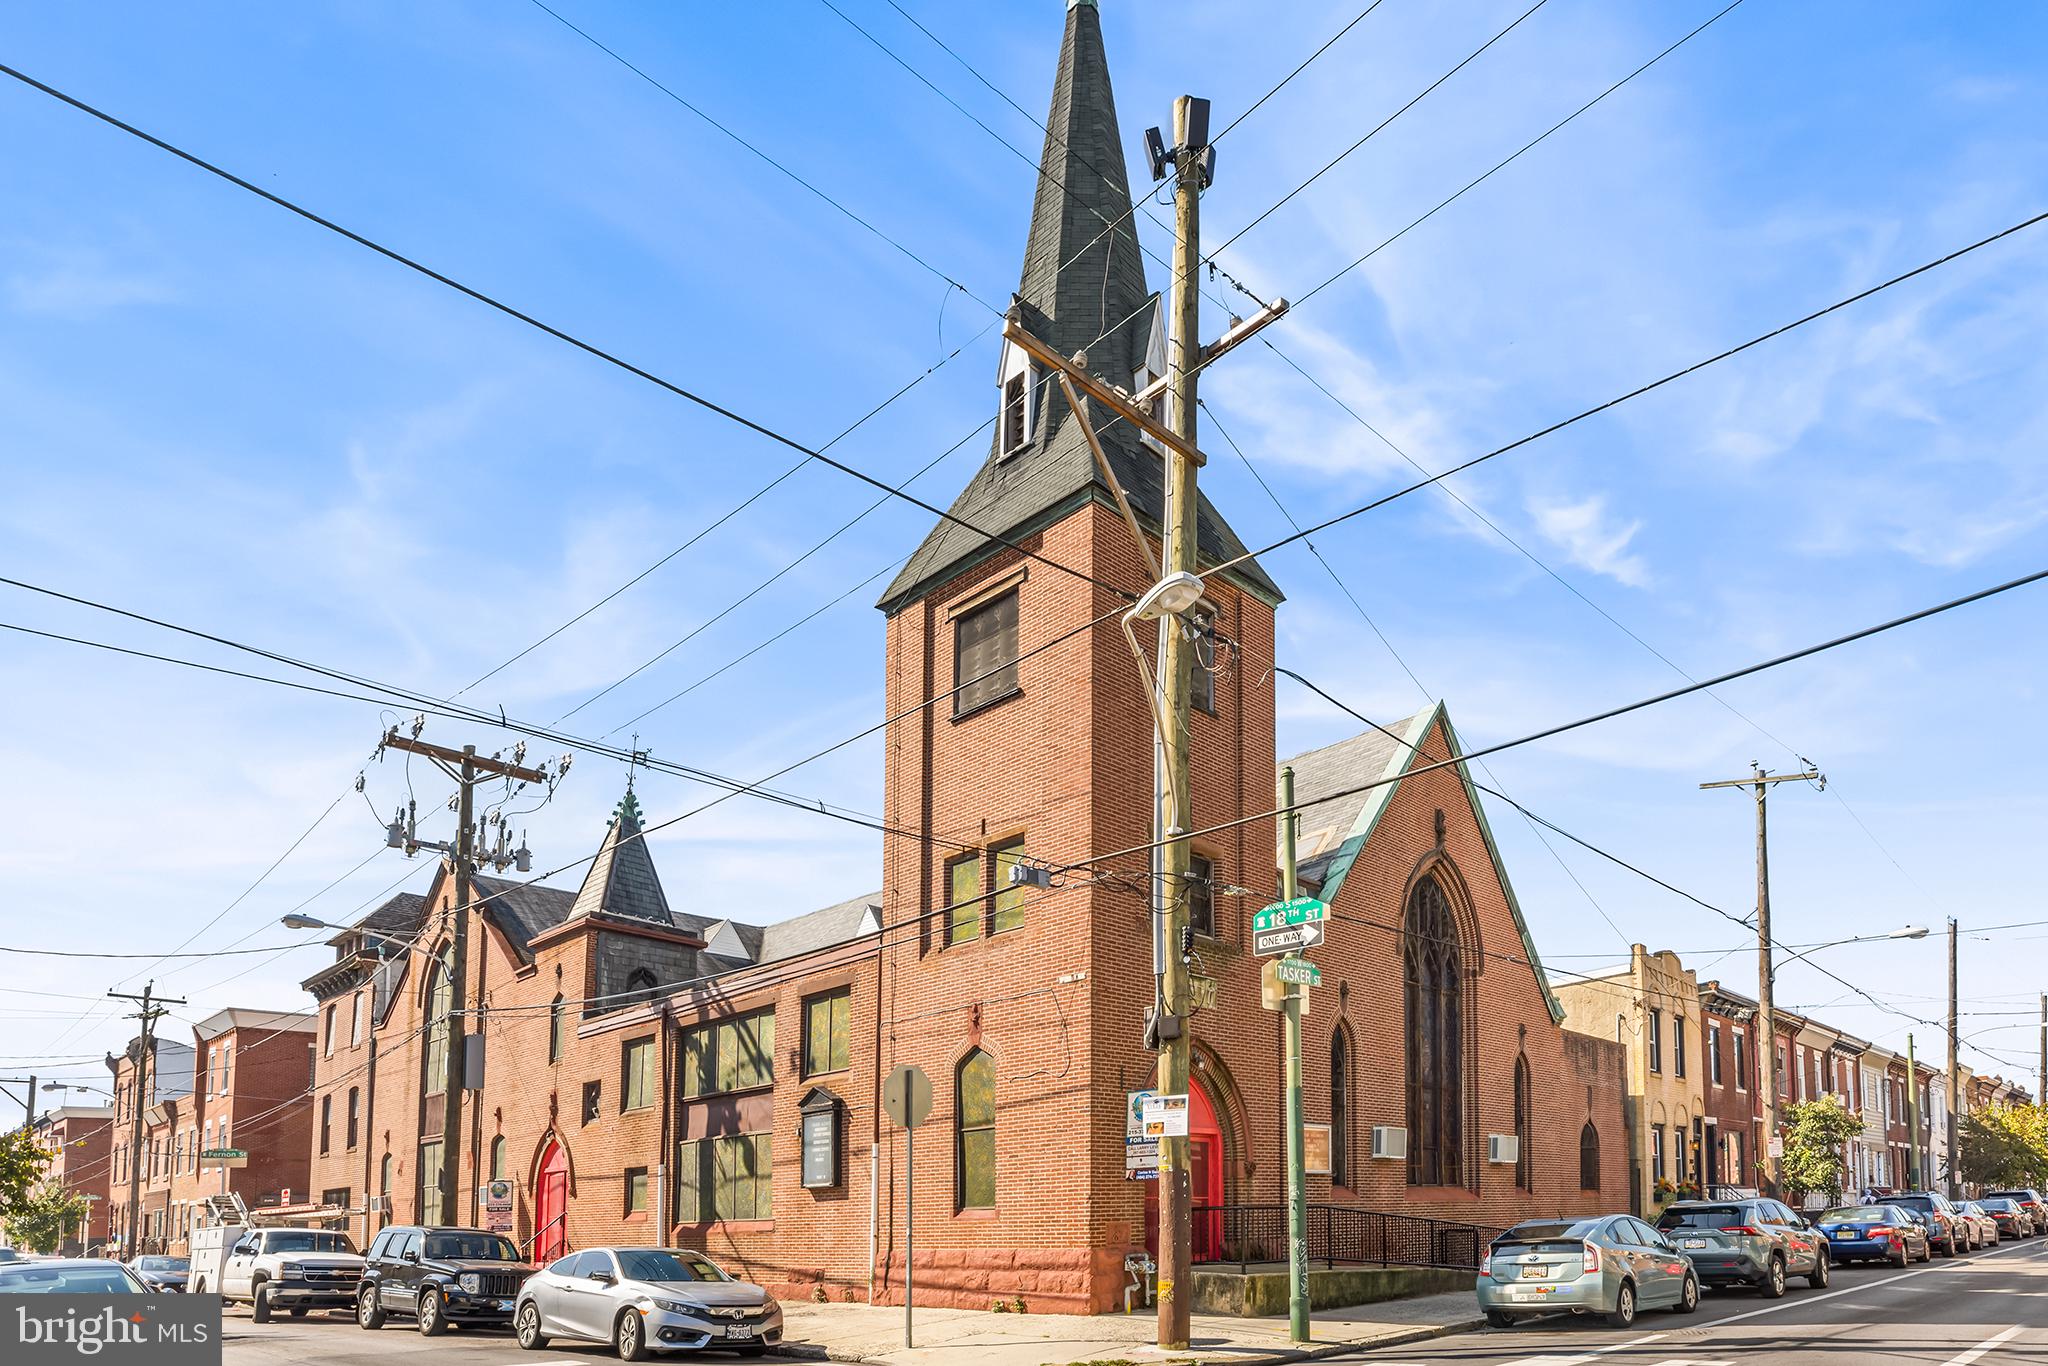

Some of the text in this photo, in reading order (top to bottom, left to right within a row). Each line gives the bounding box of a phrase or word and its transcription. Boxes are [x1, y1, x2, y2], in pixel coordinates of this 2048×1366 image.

[1286, 901, 1291, 909] S
[1292, 899, 1307, 907] 1500
[1268, 908, 1320, 927] 18TH ST
[1261, 931, 1303, 948] ONE WAY
[1278, 965, 1321, 985] TASKER ST
